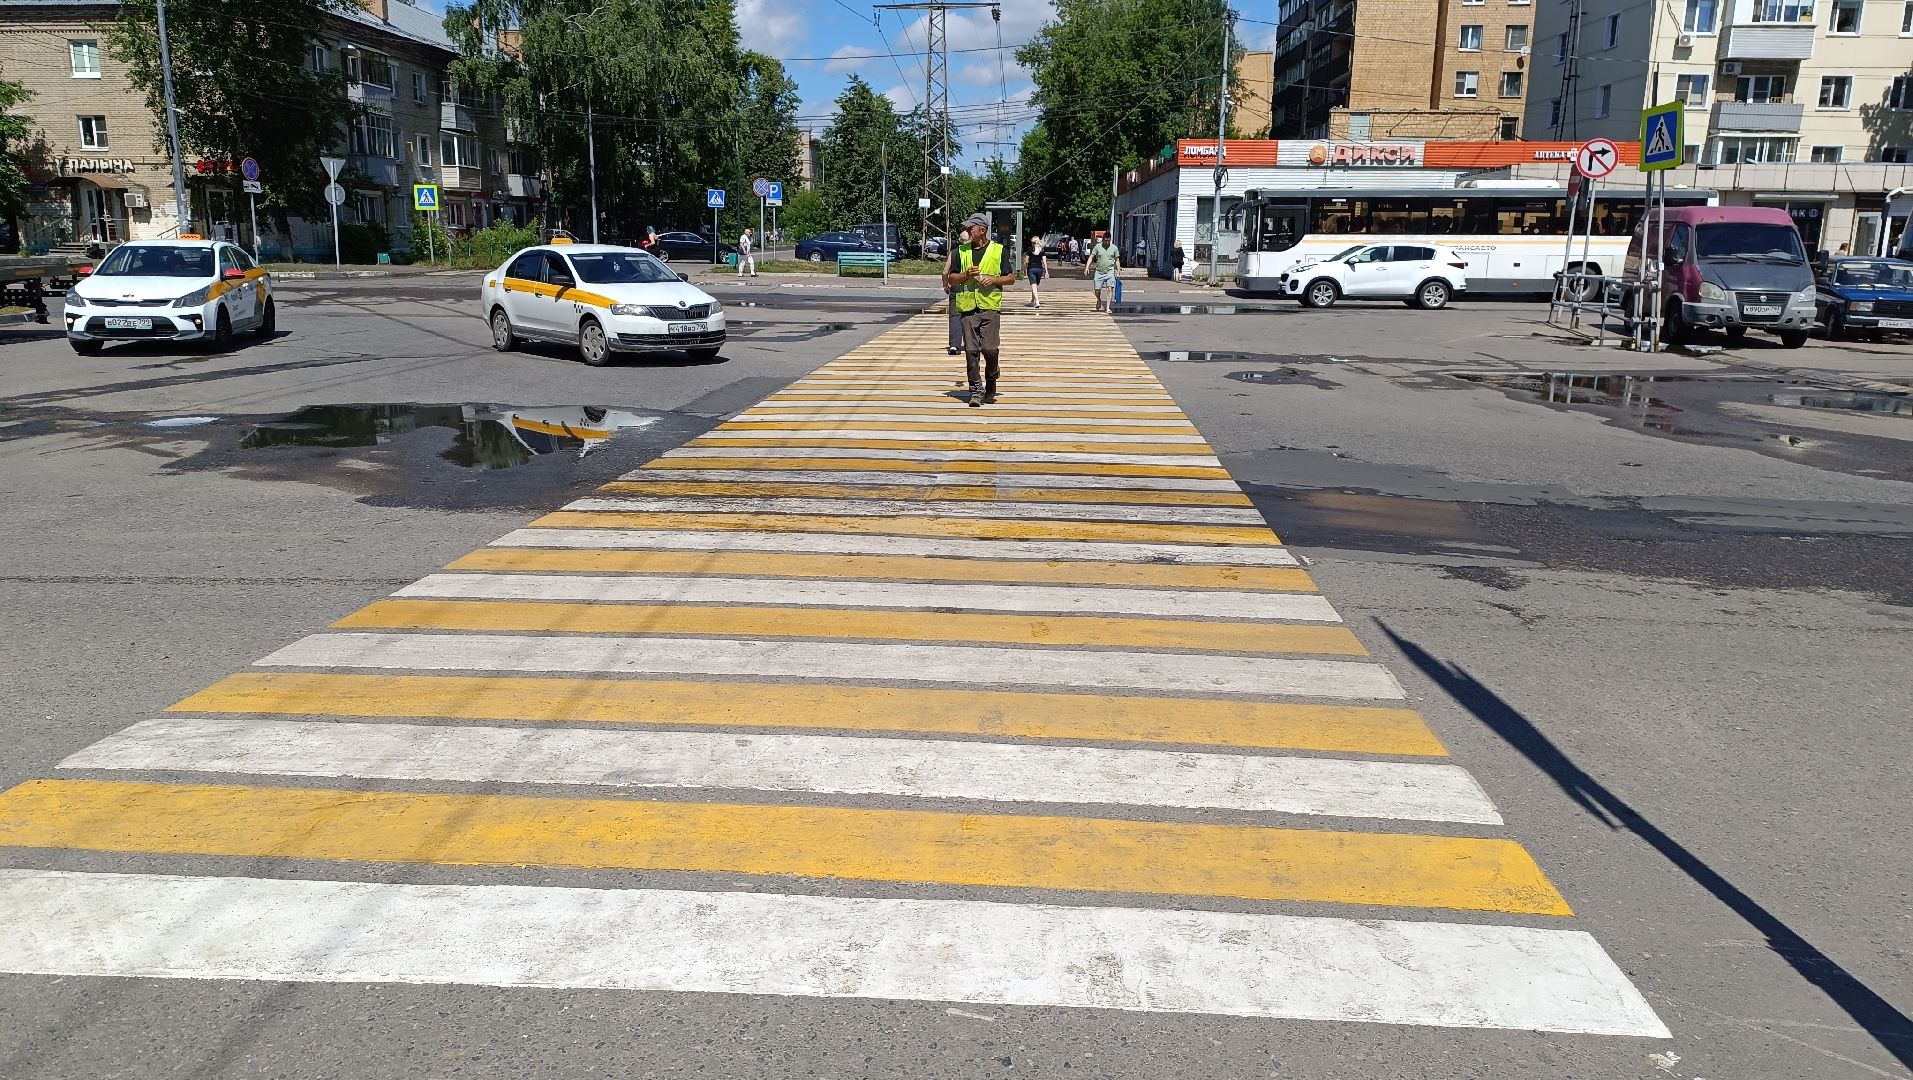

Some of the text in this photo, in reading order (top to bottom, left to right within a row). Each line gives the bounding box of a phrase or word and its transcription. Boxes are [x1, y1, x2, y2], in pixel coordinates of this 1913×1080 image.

[1333, 145, 1415, 164] ДИКСИ
[68, 158, 135, 171] ПАЛЫЧА
[770, 184, 779, 197] P
